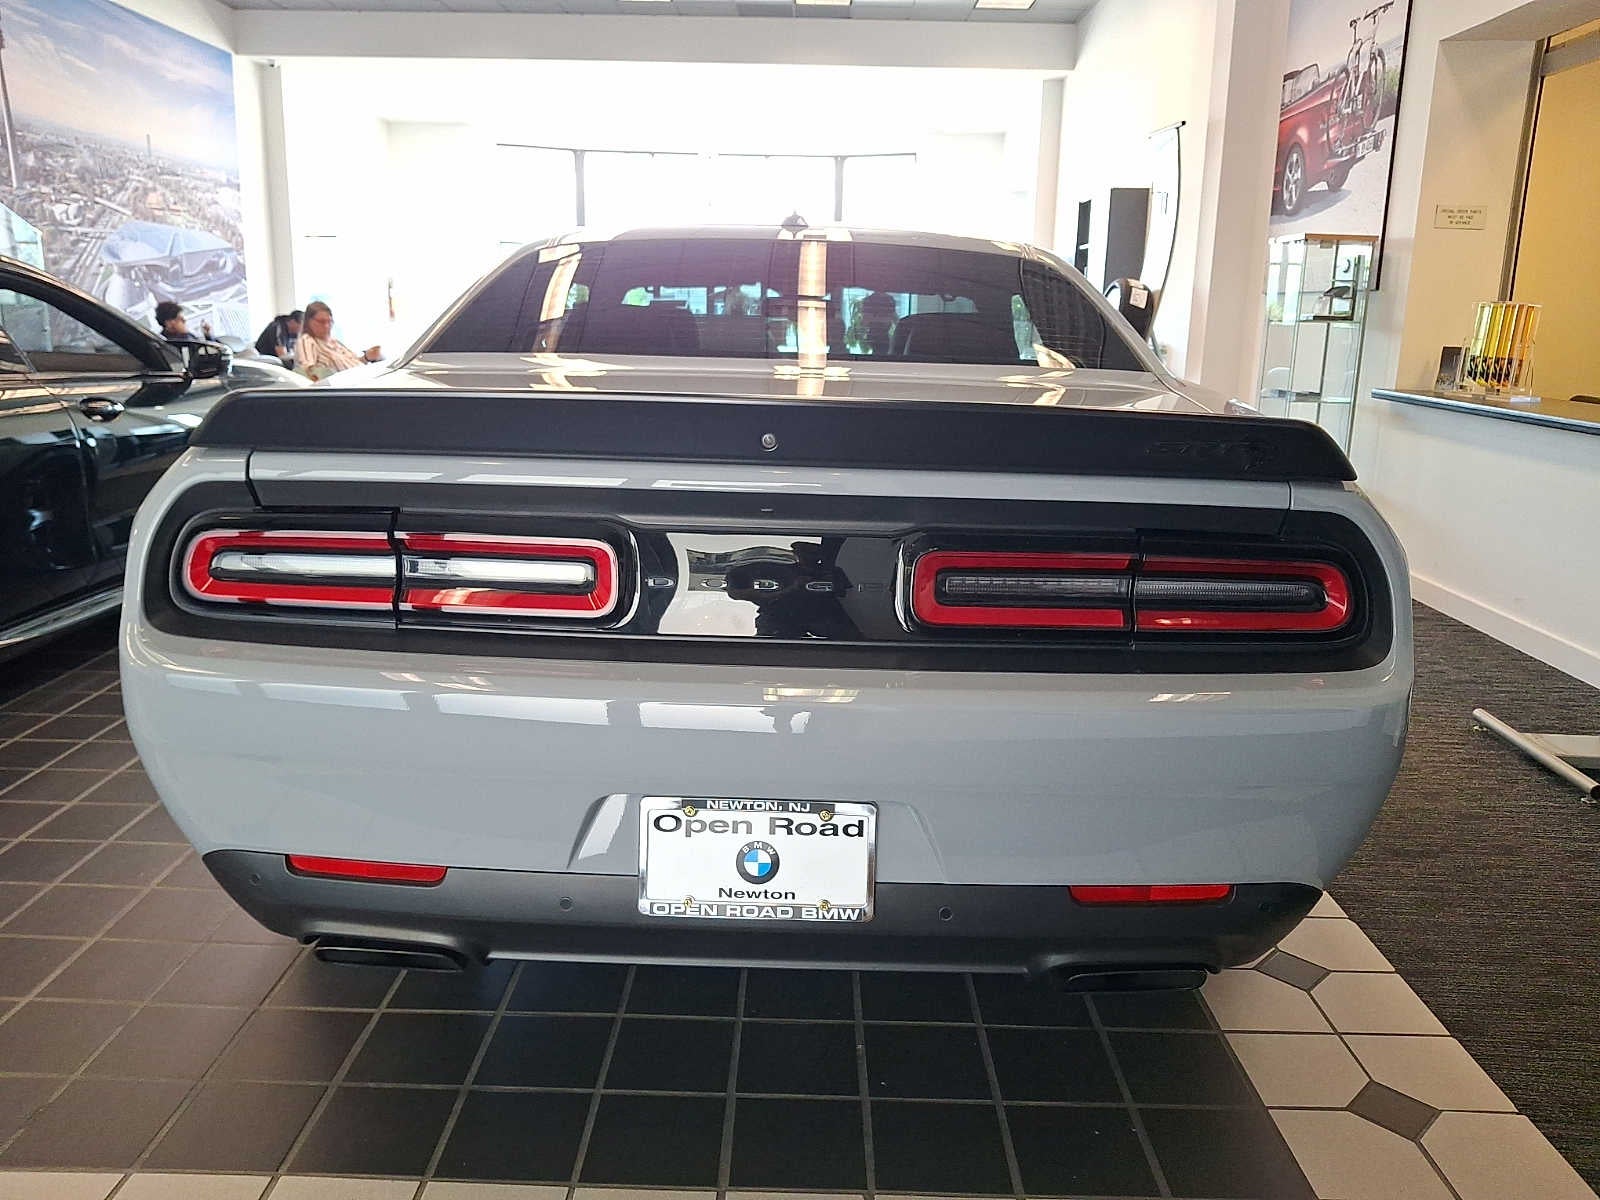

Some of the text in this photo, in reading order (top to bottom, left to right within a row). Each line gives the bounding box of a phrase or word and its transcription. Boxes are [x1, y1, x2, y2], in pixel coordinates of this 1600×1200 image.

[706, 799, 811, 813] NEWTON, NJ
[653, 813, 865, 838] Open Road
[742, 841, 776, 855] BMW
[718, 887, 796, 900] Newton
[652, 902, 861, 921] OPEN ROAD BMW
